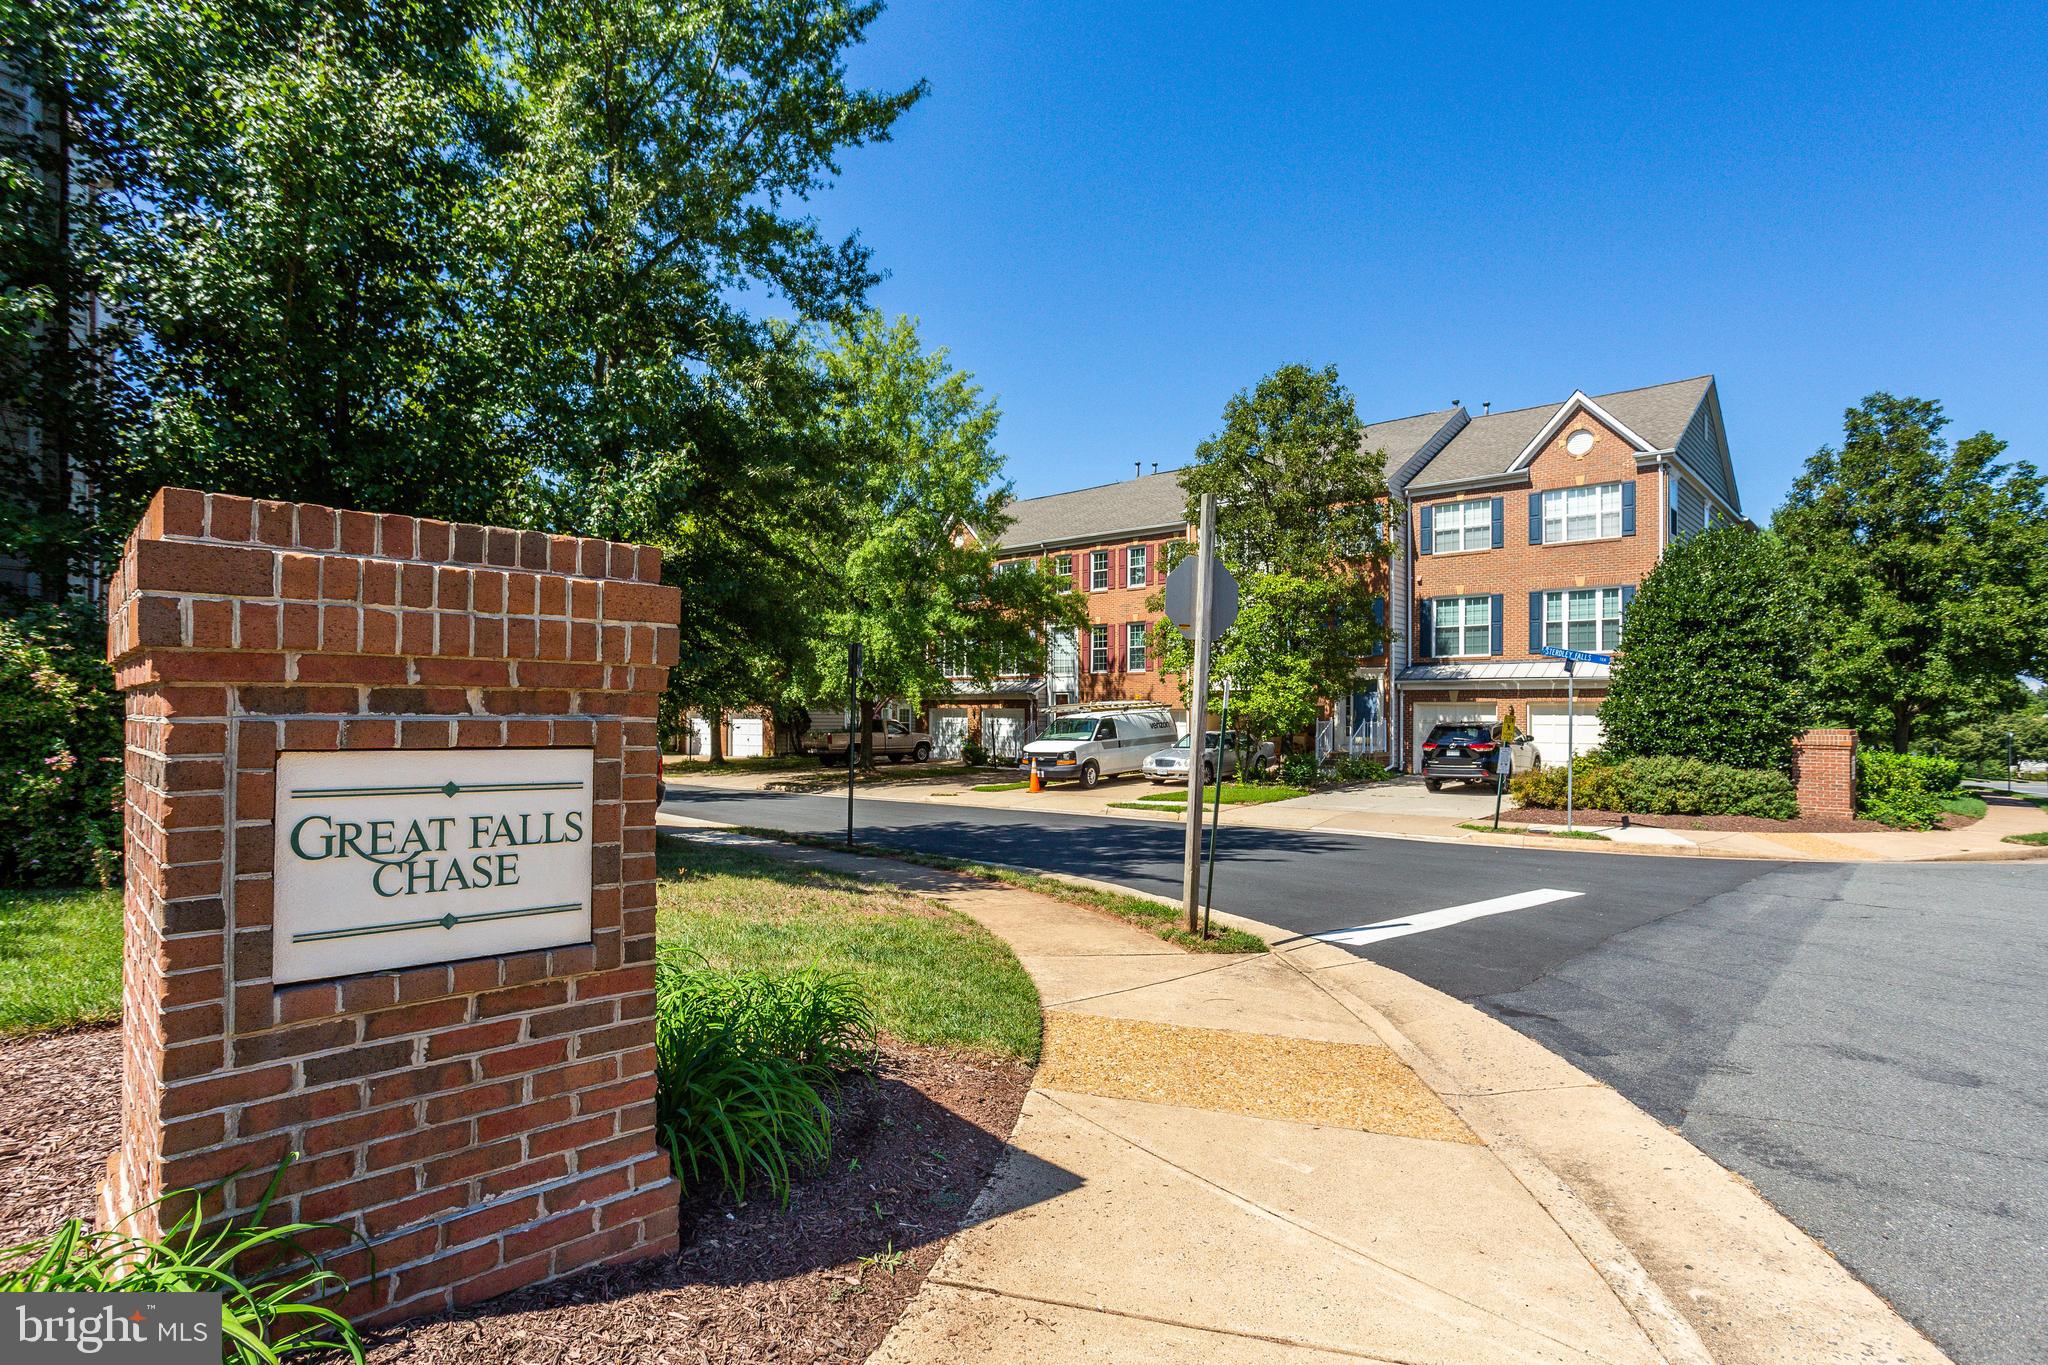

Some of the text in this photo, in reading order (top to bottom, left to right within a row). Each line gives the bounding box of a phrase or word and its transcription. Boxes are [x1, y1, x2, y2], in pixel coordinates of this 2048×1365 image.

[1574, 652, 1592, 661] FALLS
[1150, 720, 1170, 729] verizon
[290, 811, 584, 864] GREAT FALLS
[372, 853, 520, 898] CHASE
